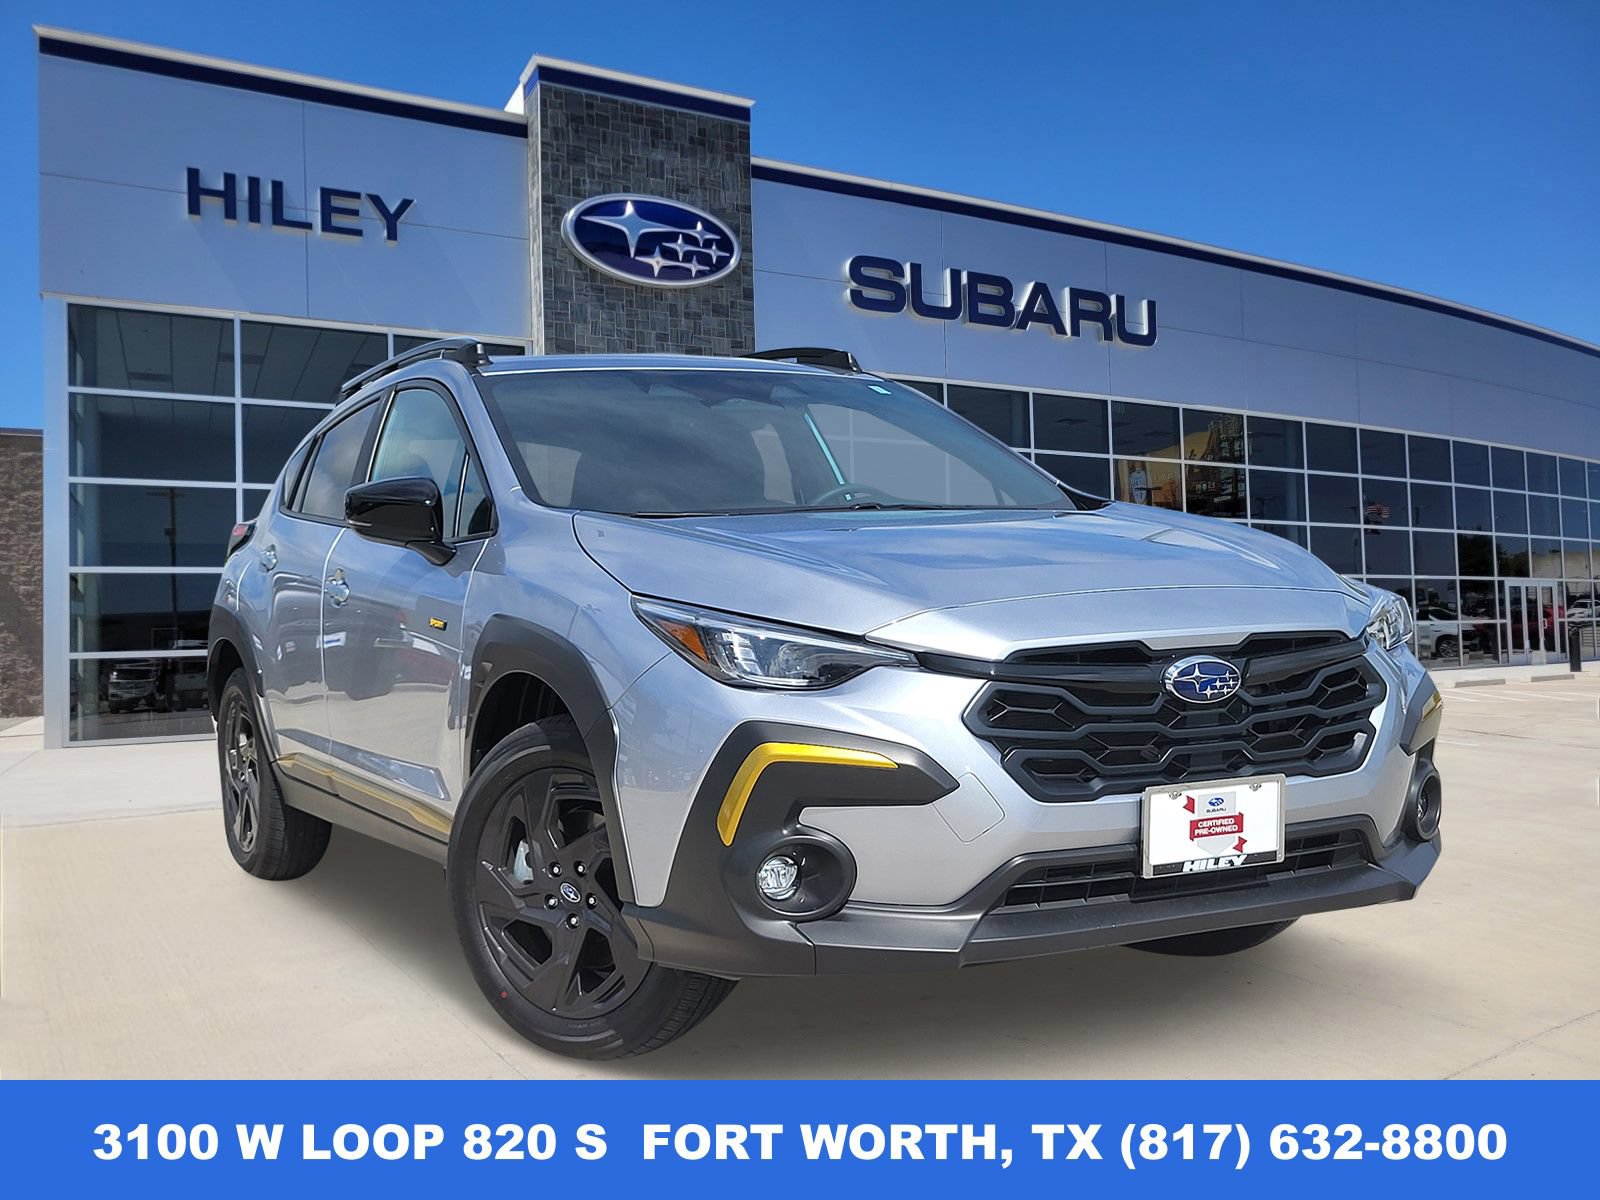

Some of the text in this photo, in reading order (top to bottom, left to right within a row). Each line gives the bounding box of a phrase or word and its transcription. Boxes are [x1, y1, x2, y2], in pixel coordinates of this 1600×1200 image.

[187, 167, 416, 244] HILEY
[846, 254, 1158, 348] SUBARU
[1194, 825, 1238, 835] PRE-OWNED
[1198, 818, 1235, 828] CERTIFIED
[1182, 854, 1247, 872] HILEY
